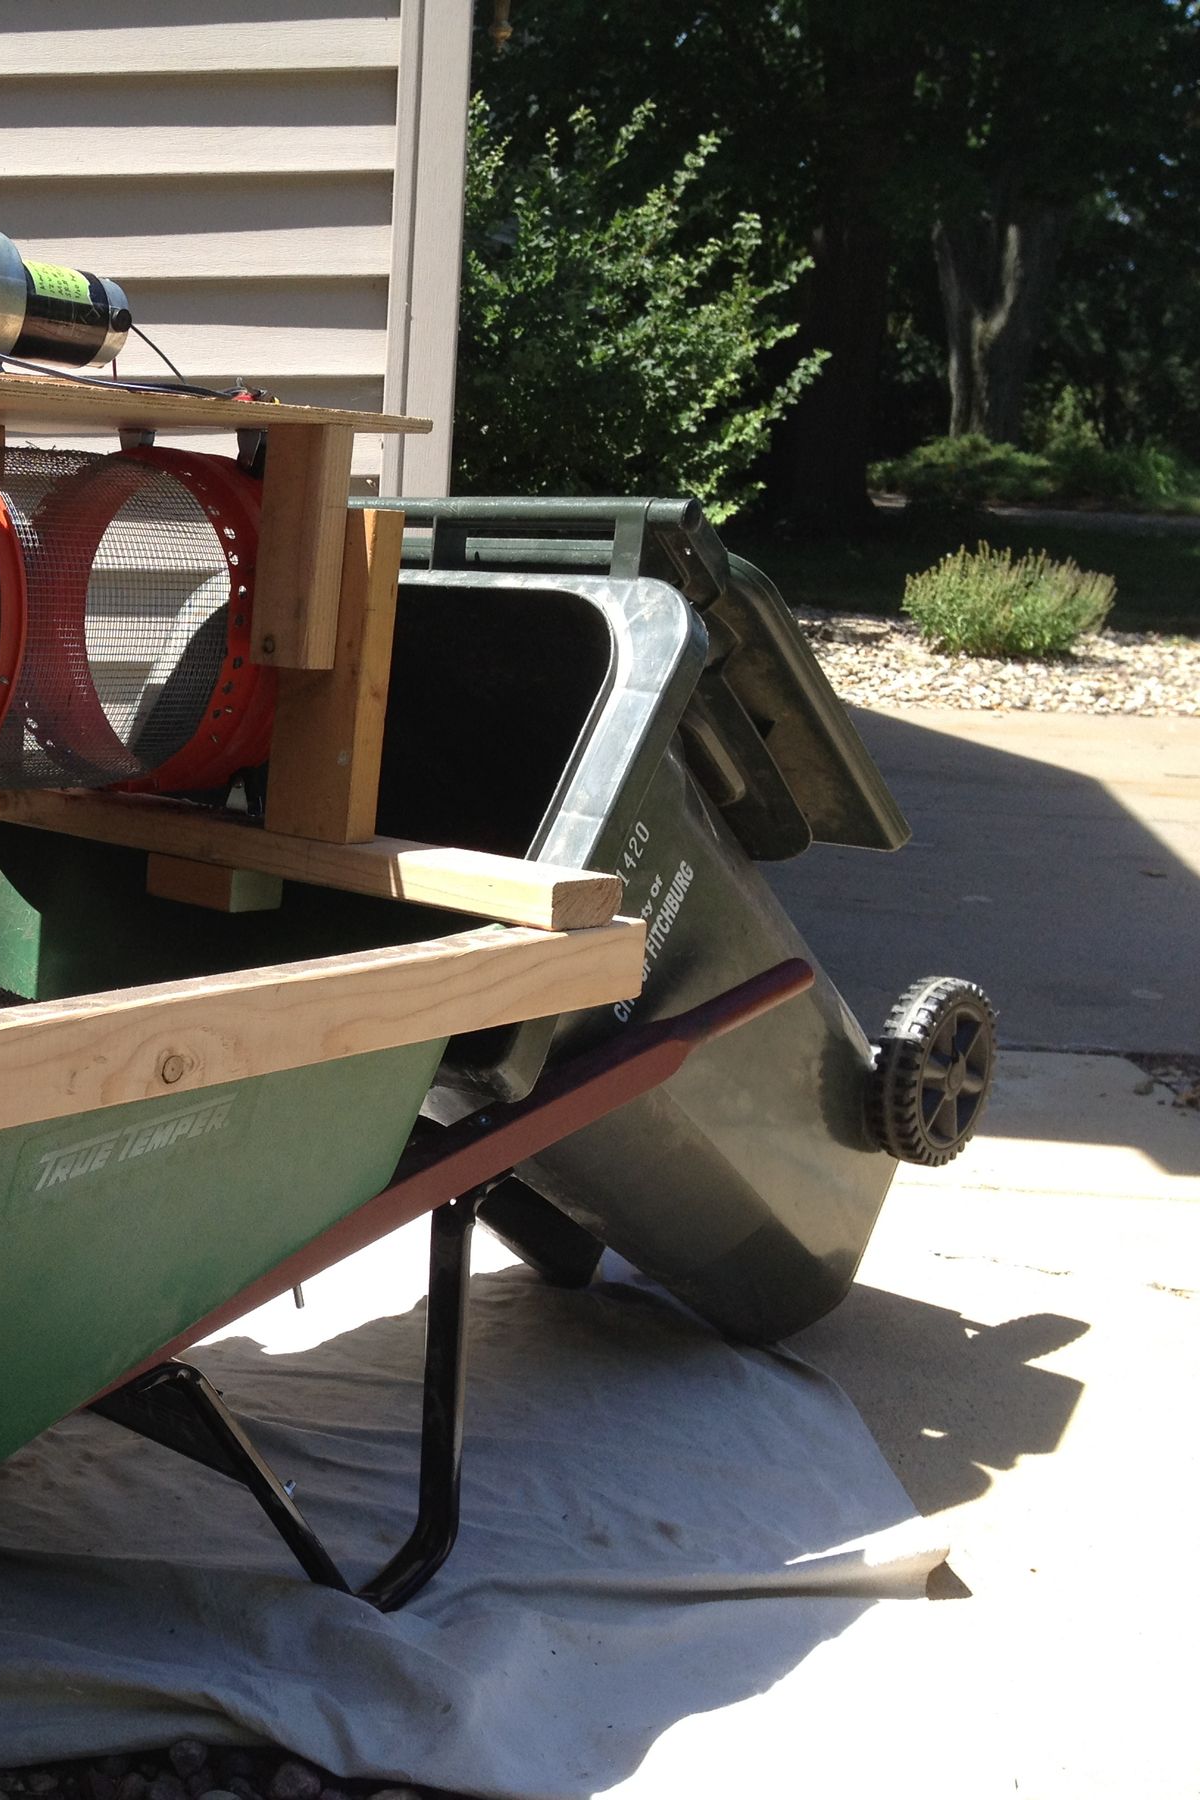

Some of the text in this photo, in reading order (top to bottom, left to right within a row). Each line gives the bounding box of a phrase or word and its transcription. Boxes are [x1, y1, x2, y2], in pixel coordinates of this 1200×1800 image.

[615, 821, 650, 887] 1420
[645, 860, 694, 959] FITCHBURG
[35, 1091, 239, 1192] TRUE TEMPER
